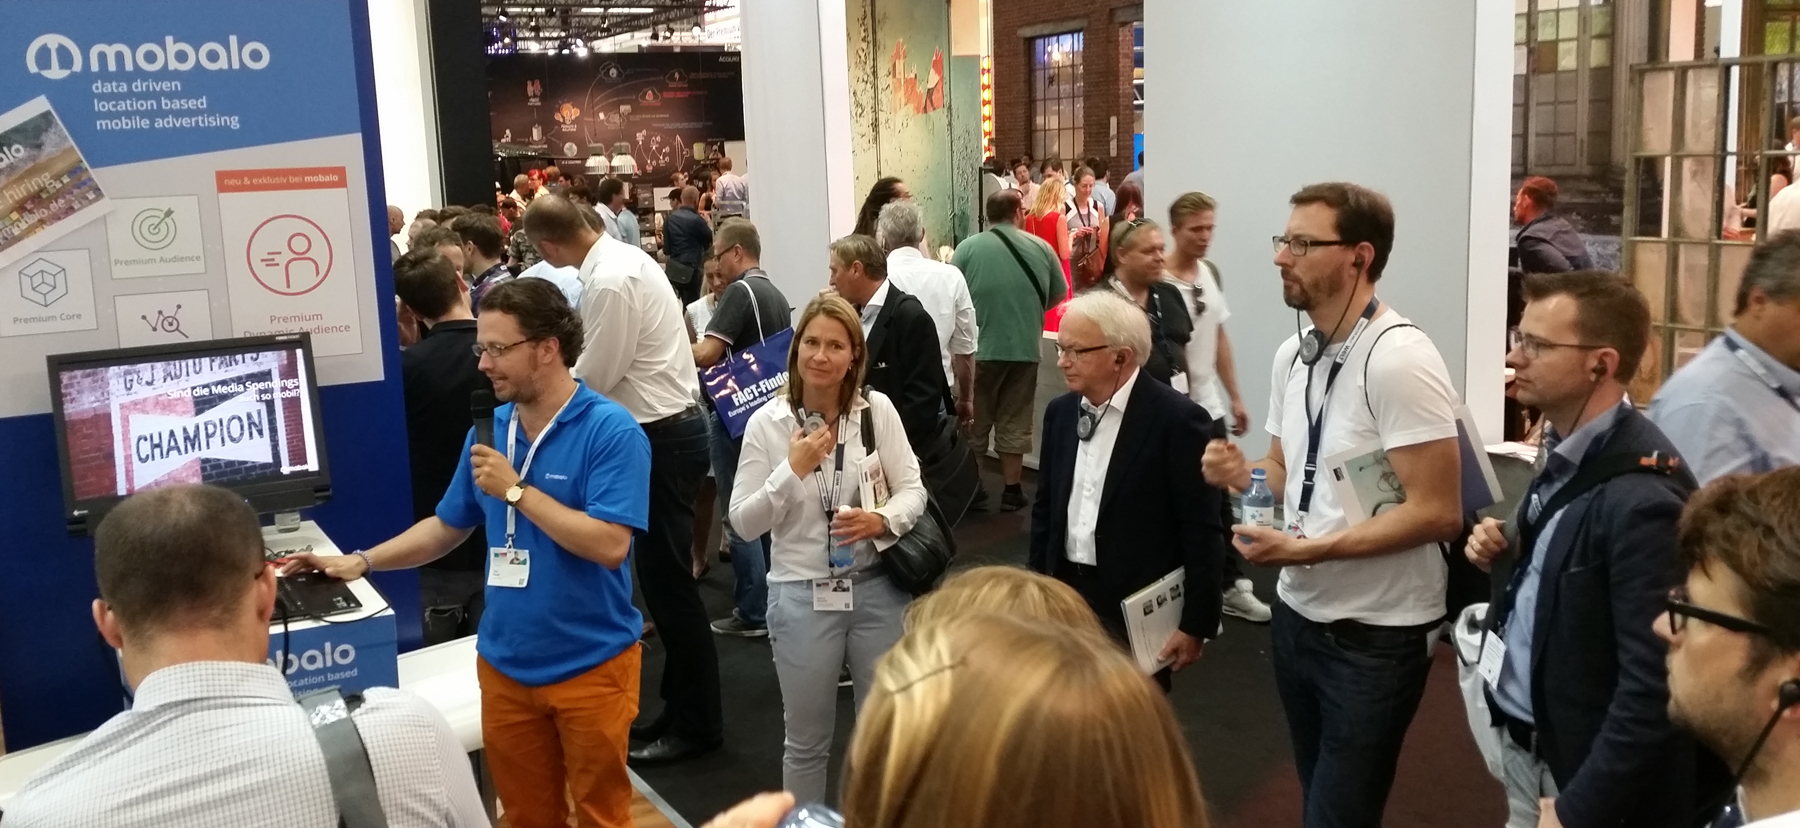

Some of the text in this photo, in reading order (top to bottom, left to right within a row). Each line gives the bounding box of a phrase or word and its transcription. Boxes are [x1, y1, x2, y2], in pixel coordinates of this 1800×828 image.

[90, 35, 270, 72] mobalo
[92, 79, 181, 93] data driven
[94, 95, 207, 112] location based
[96, 114, 240, 130] mobile advertising
[3, 172, 55, 203] hiring
[224, 174, 339, 186] neu & exklusiv bei mobalo
[114, 254, 201, 267] Premium Audience
[13, 312, 82, 325] Premium Core
[270, 313, 323, 325] Premium
[299, 324, 351, 335] Audience
[167, 378, 299, 400] Sind die Media Spendings
[260, 393, 272, 401] so
[273, 389, 300, 399] mobil?
[731, 371, 790, 406] FACT-Finde
[728, 402, 750, 418] Europe's
[136, 408, 265, 464] CHAMPION
[266, 641, 356, 675] balo
[287, 667, 358, 688] ocation based
